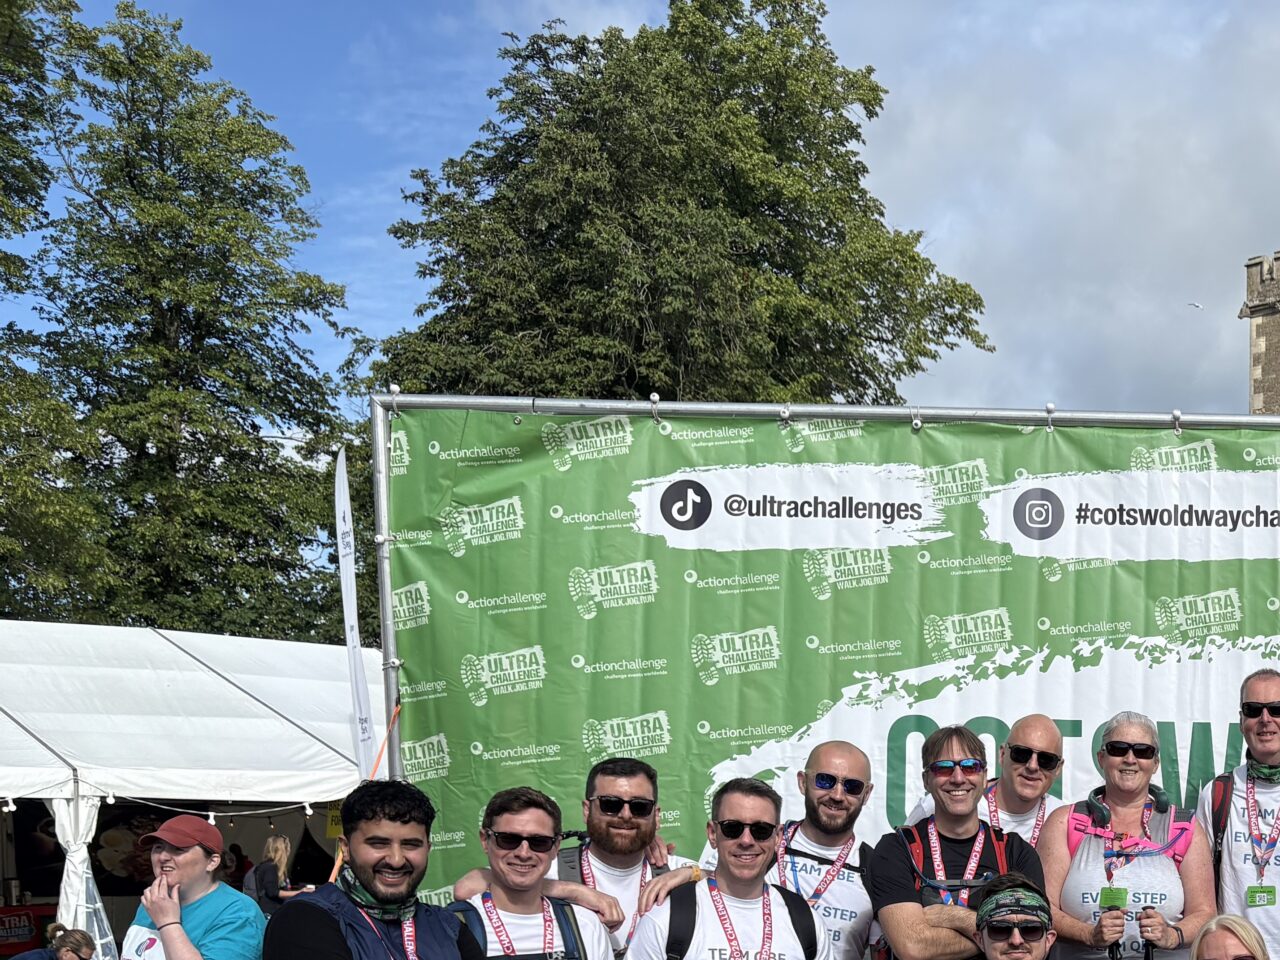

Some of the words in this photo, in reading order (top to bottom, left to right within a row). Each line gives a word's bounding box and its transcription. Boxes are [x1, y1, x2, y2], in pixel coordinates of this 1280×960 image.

[571, 419, 627, 441] ULTRA
[671, 426, 754, 440] actionchallenge
[810, 428, 862, 442] WALK.JOG.RUN
[576, 435, 628, 452] CHALLENGE
[578, 447, 629, 461] WALK.JOG.RUN
[1160, 446, 1211, 467] ULTRA
[930, 464, 982, 486] ULTRA
[933, 481, 984, 496] CHALLENGE
[467, 502, 517, 525] ULTRA
[724, 494, 923, 525] @ultrachallenges
[470, 519, 519, 536] CHALLENGE
[471, 530, 521, 546] WALK.JOG.RUN
[831, 549, 885, 569] ULTRA
[930, 554, 1012, 569] actionchallenge
[597, 567, 651, 588] ULTRA
[834, 563, 887, 579] CHALLENGE
[696, 573, 780, 588] actionchallenge
[836, 575, 889, 590] WALK.JOG.RUN
[467, 591, 547, 608] actionchallenge
[600, 583, 653, 599] CHALLENGE
[602, 594, 655, 609] WALK.JOG.RUN
[1182, 595, 1236, 616] ULTRA
[952, 613, 1006, 635] ULTRA
[1185, 610, 1238, 627] CHALLENGE
[1050, 620, 1131, 636] actionchallenge
[1188, 622, 1239, 638] WALK.JOG.RUN
[719, 631, 773, 654] ULTRA
[819, 639, 902, 654] actionchallenge
[955, 630, 1007, 646] CHALLENGE
[487, 652, 540, 674] ULTRA
[722, 648, 775, 665] CHALLENGE
[584, 657, 667, 674] actionchallenge
[724, 660, 777, 676] WALK.JOG.RUN
[490, 669, 542, 686] CHALLENGE
[493, 680, 543, 696] WALK.JOG.RUN
[609, 717, 664, 739] ULTRA
[709, 723, 793, 740] actionchallenge
[403, 740, 444, 762] ULTRA
[613, 733, 665, 752] CHALLENGE
[482, 743, 561, 760] actionchallenge
[405, 758, 449, 773] CHALLENGE
[1132, 892, 1167, 905] STEP
[822, 906, 858, 921] STEP
[484, 900, 515, 955] CHALLENGER
